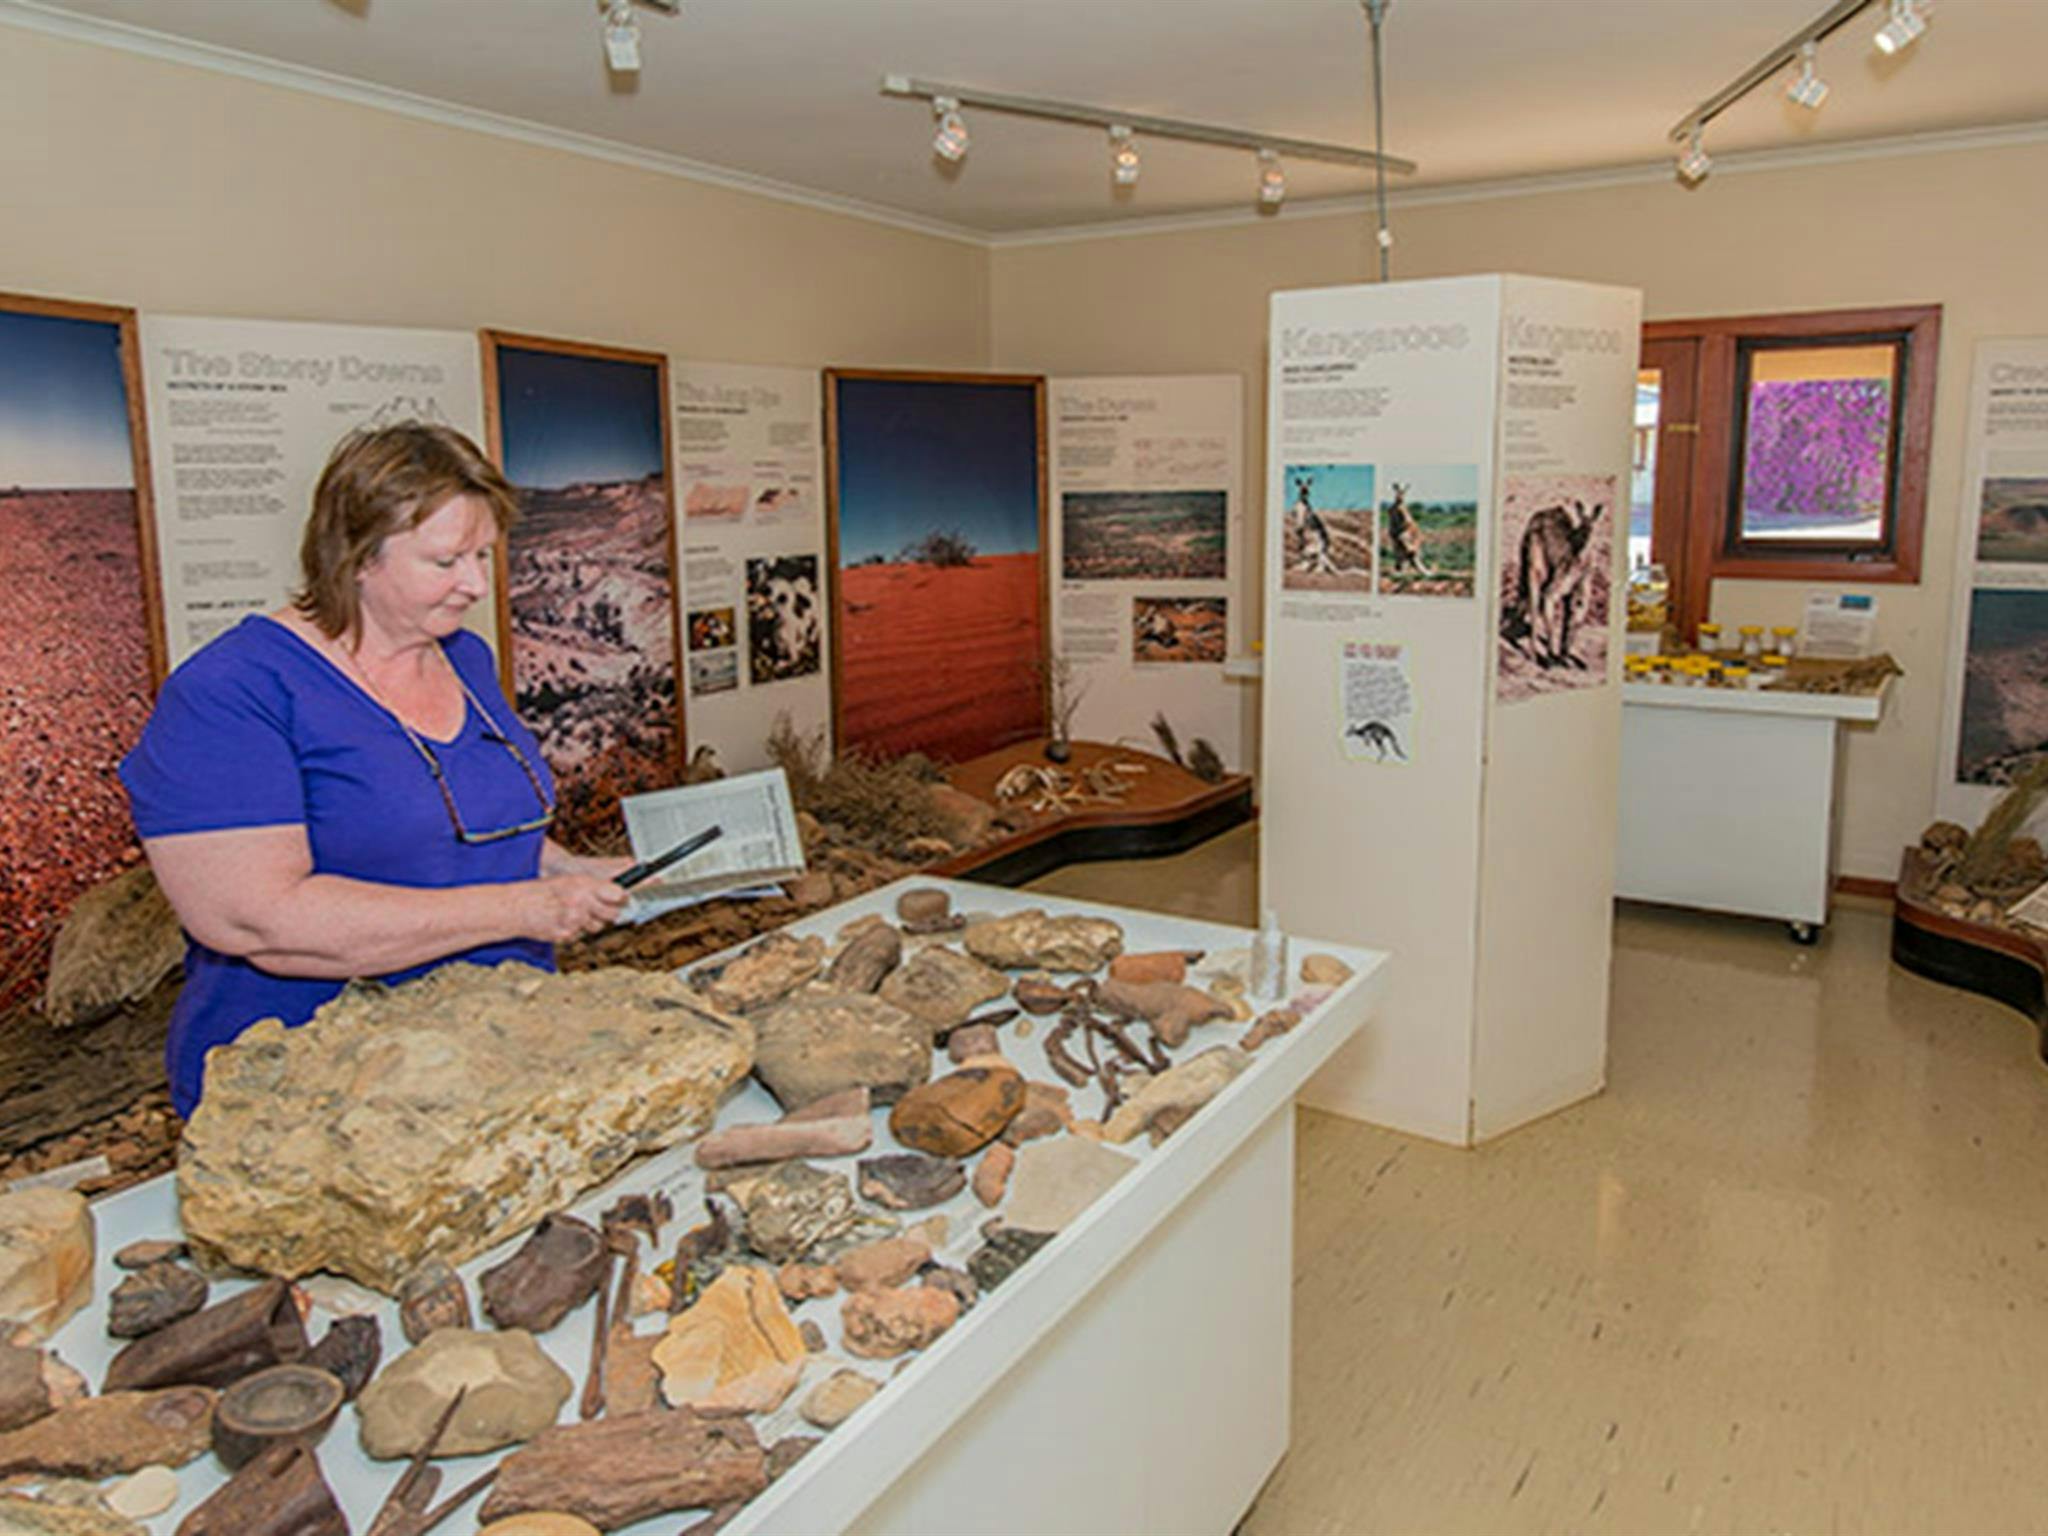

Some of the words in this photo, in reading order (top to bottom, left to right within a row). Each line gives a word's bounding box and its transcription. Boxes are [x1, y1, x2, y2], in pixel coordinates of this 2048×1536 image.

[1282, 323, 1470, 360] Kangaroos
[161, 347, 232, 378] The
[237, 350, 333, 388] Stony
[337, 354, 445, 384] Downs
